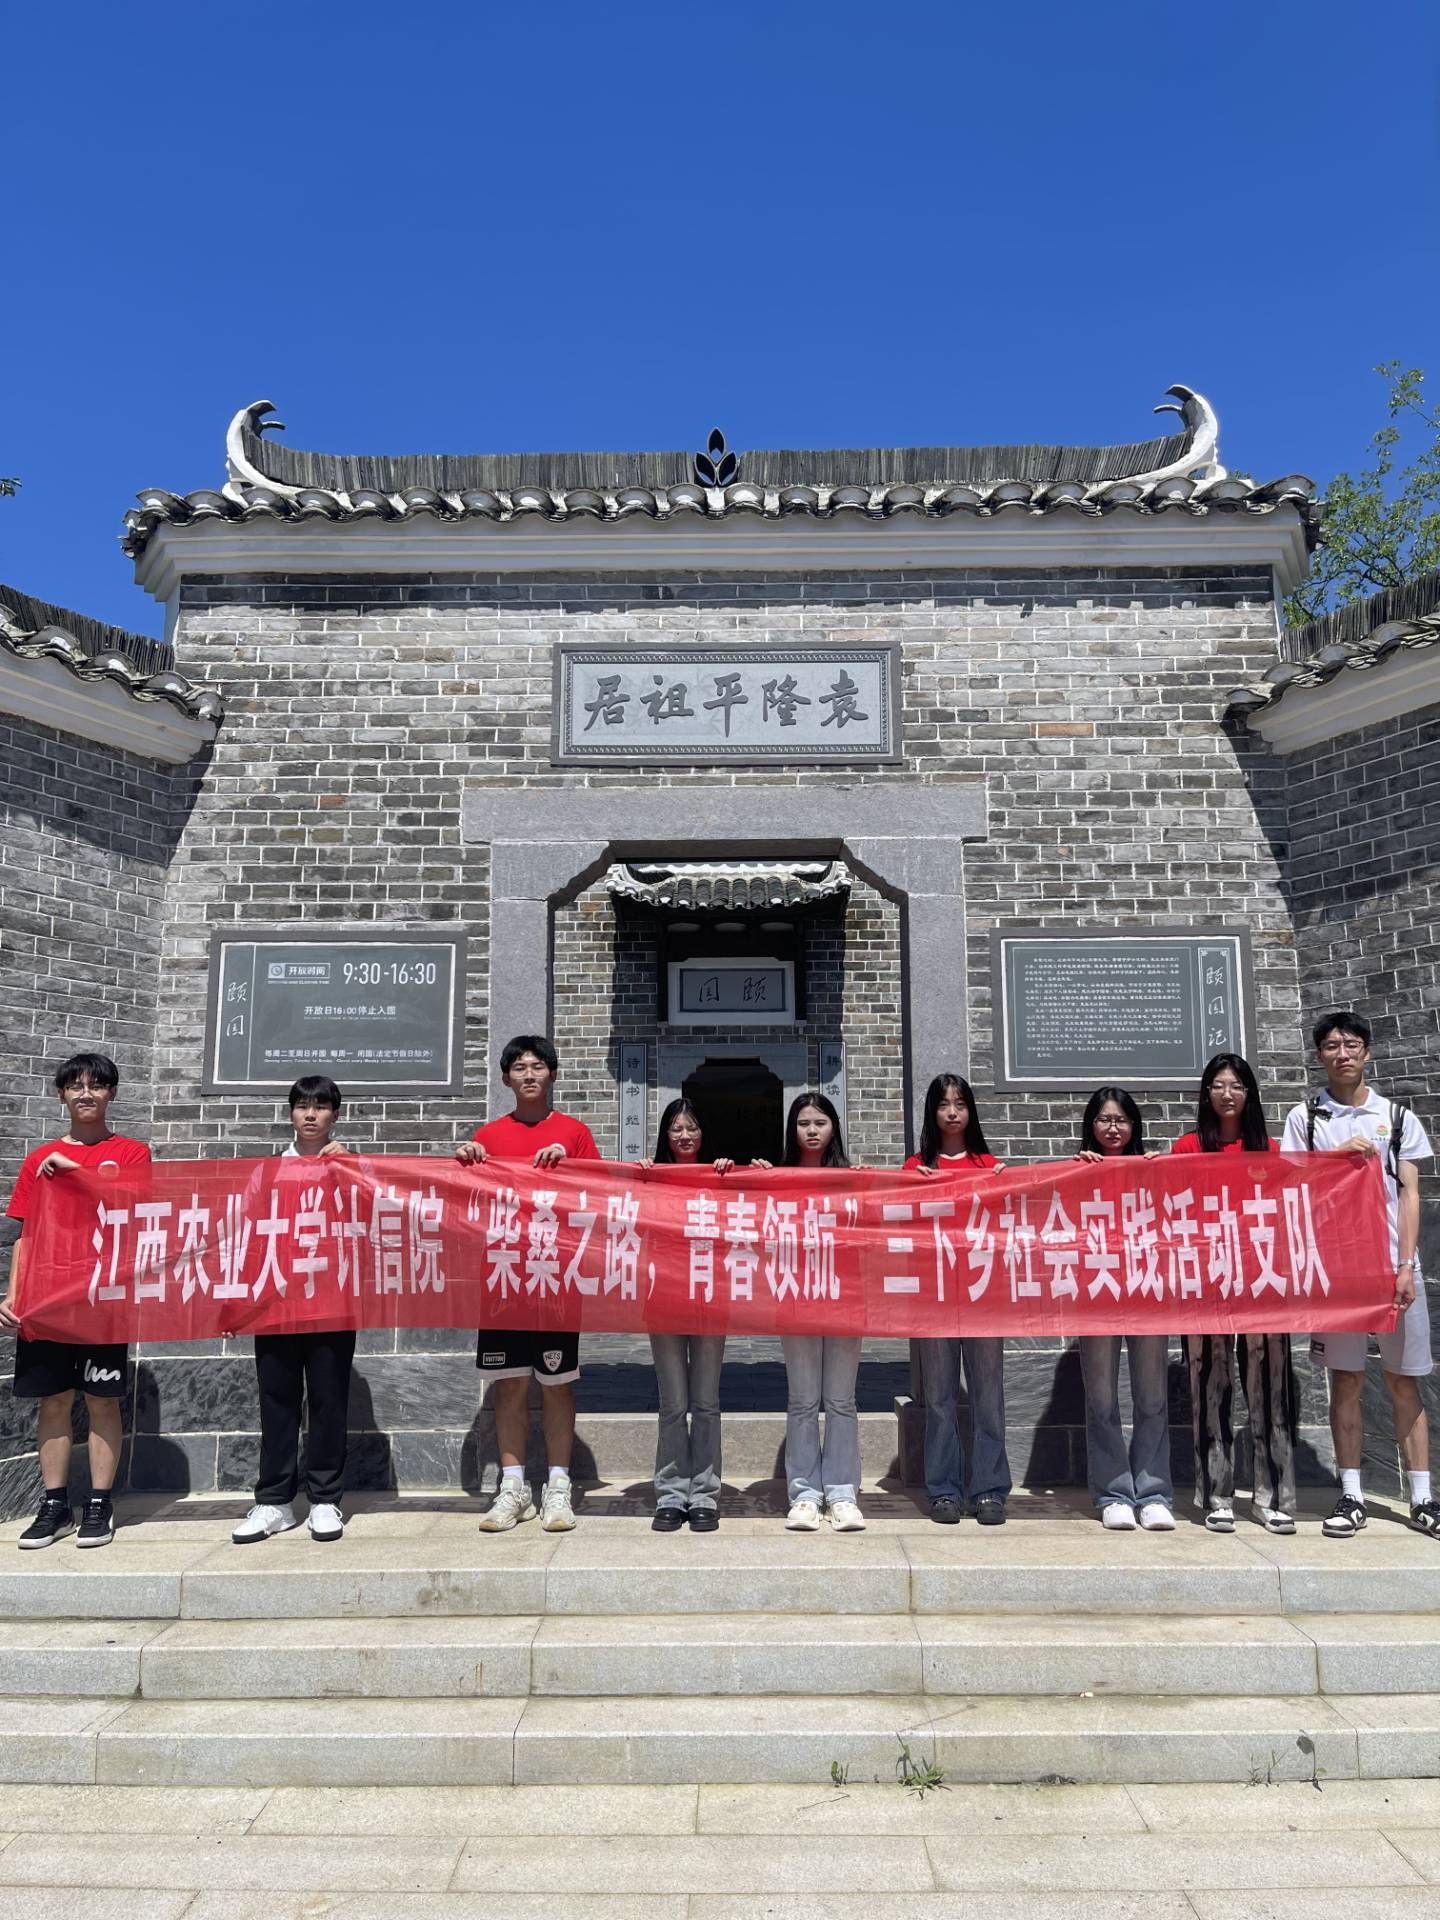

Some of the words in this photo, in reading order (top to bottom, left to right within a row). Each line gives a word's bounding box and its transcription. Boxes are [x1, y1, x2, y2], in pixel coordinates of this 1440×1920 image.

[288, 966, 326, 976] 开放时间
[343, 962, 437, 985] 9:30-16:30
[545, 1352, 561, 1361] NETS
